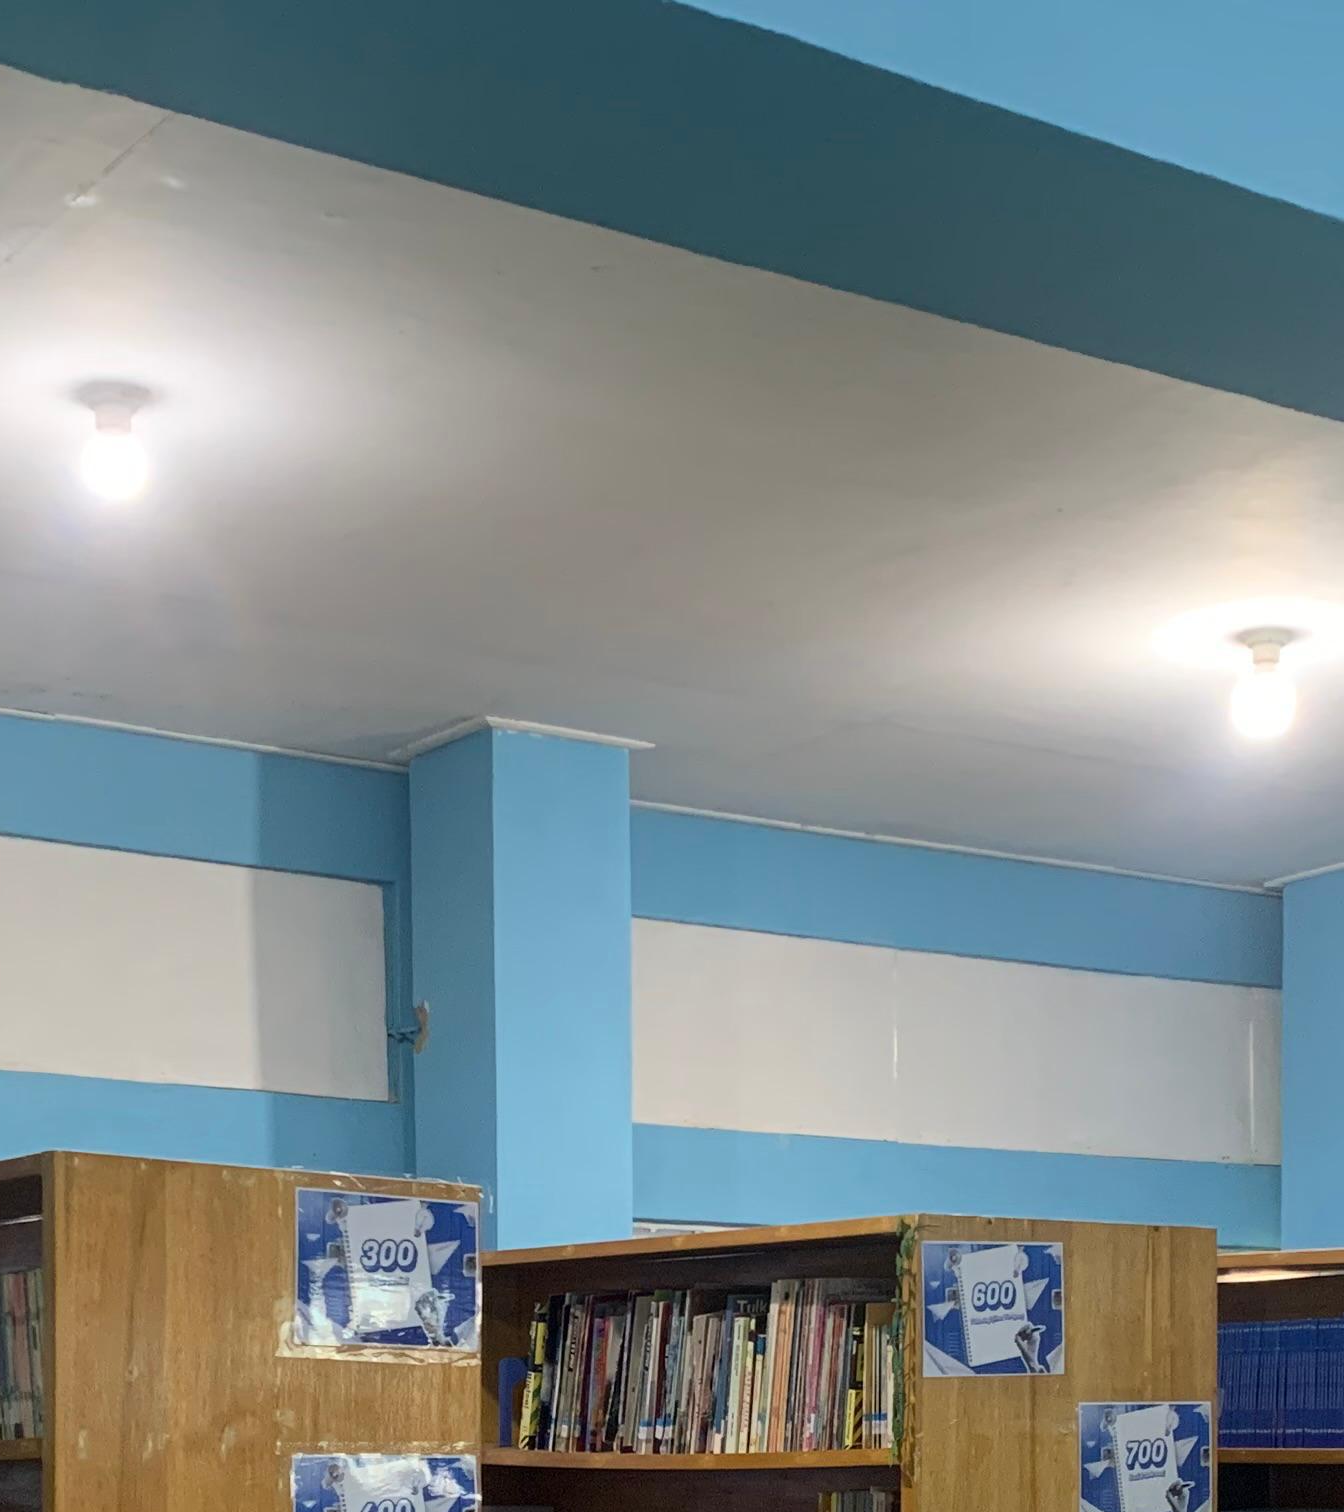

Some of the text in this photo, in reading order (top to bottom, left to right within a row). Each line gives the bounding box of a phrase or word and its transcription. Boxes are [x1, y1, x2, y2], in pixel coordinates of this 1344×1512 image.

[360, 1239, 418, 1273] 300
[971, 1280, 1016, 1312] 600
[1126, 1438, 1168, 1471] 700
